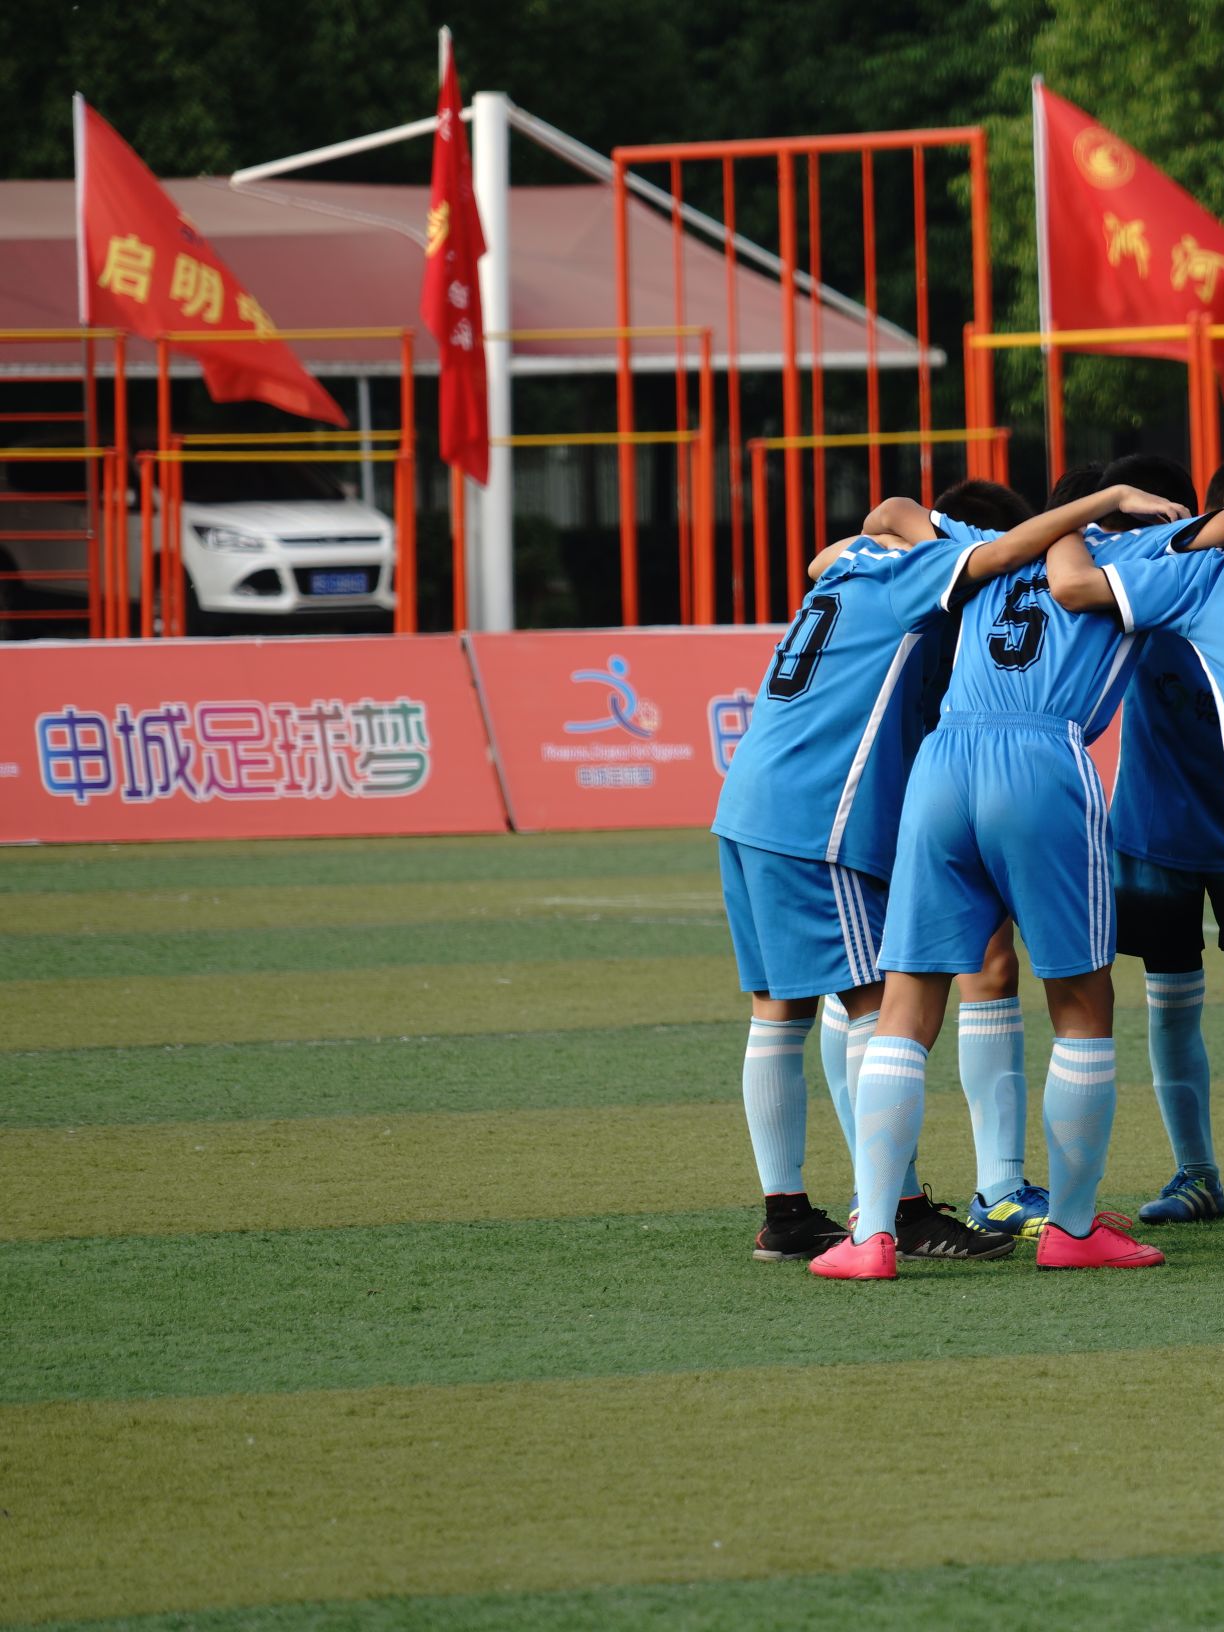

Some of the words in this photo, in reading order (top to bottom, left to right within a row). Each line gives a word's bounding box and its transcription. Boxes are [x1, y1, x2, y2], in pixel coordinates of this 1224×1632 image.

[987, 574, 1050, 672] 5
[36, 695, 430, 805] 申城足球梦
